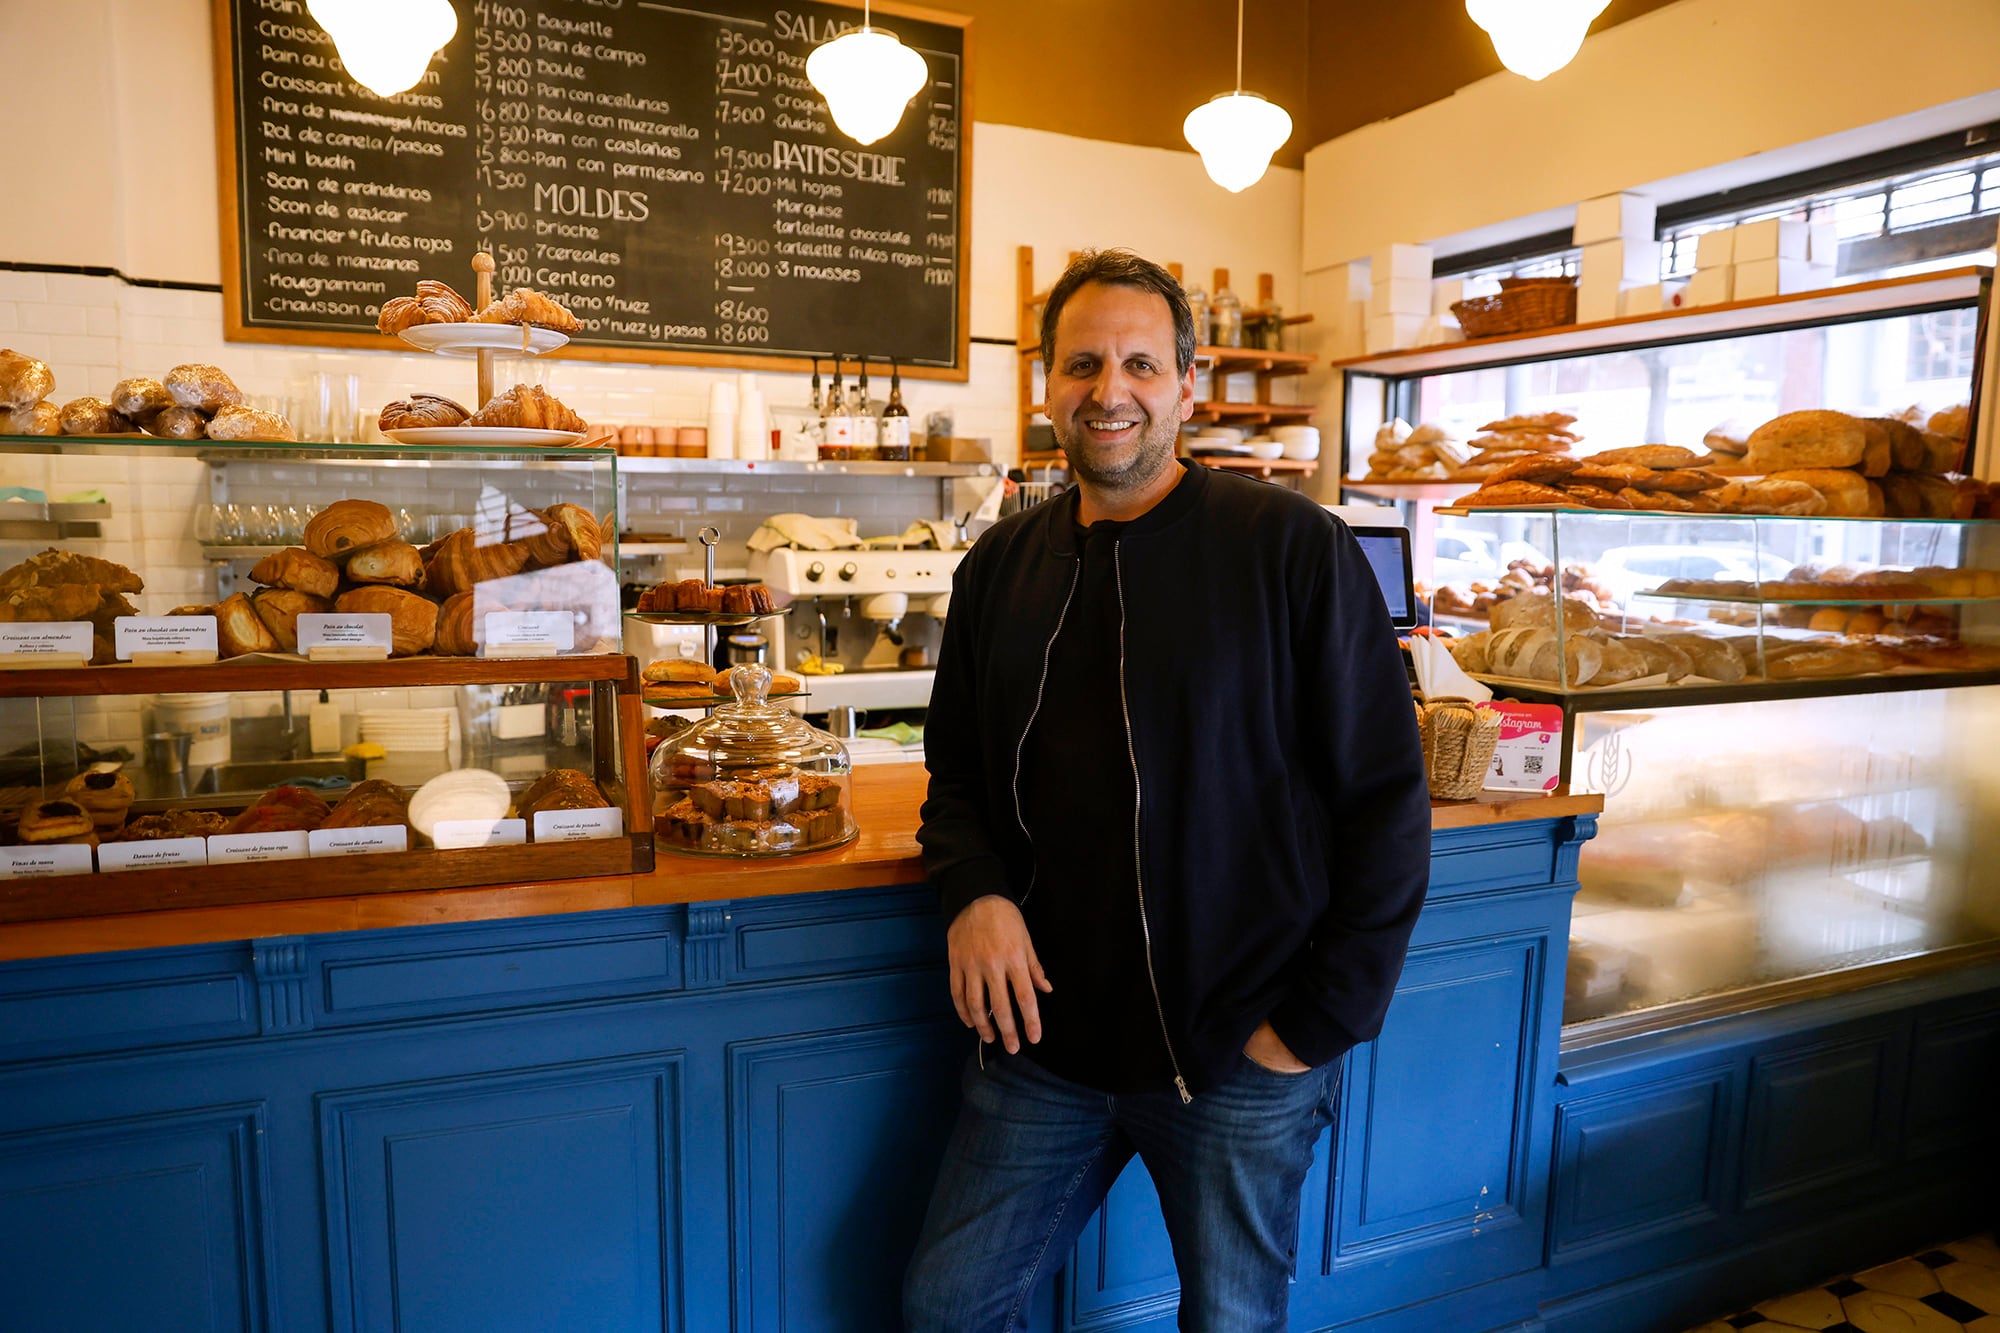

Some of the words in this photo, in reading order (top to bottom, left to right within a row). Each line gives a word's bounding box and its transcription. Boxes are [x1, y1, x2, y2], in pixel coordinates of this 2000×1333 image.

[259, 20, 332, 43] Croissa
[262, 45, 299, 64] Pain
[302, 54, 324, 67] au
[537, 35, 568, 53] Pan
[571, 41, 592, 58] de
[536, 58, 586, 80] Boule
[777, 51, 806, 70] Pizz
[261, 71, 345, 97] Croissant
[537, 82, 567, 99] Pan
[568, 89, 594, 103] con
[596, 93, 669, 114] aceitunas
[302, 103, 324, 119] de
[537, 104, 586, 126] Boule
[587, 114, 615, 128] con
[617, 117, 699, 139] muzzarella
[299, 127, 323, 144] de
[325, 132, 382, 149] canela
[536, 128, 565, 145] Pan
[571, 135, 598, 148] con
[536, 151, 567, 170] Pan
[577, 158, 605, 173] con
[613, 162, 705, 184] parmesano
[773, 139, 906, 186] PATISSERIE
[266, 171, 309, 191] Scon
[317, 177, 340, 193] de
[802, 180, 843, 199] hojas
[268, 196, 311, 215] Scon
[315, 201, 340, 218] de
[533, 181, 649, 222] MOLDES
[536, 219, 599, 240] Brioche
[849, 227, 911, 246] chocolate
[413, 236, 453, 255] rojos
[308, 252, 330, 266] de
[336, 255, 420, 272] manzanas
[536, 268, 616, 288] Centeno
[793, 263, 861, 283] mousses
[269, 297, 360, 316] Chausson
[650, 324, 660, 339] y
[664, 324, 708, 340] pasas
[1501, 716, 1543, 733] stagram
